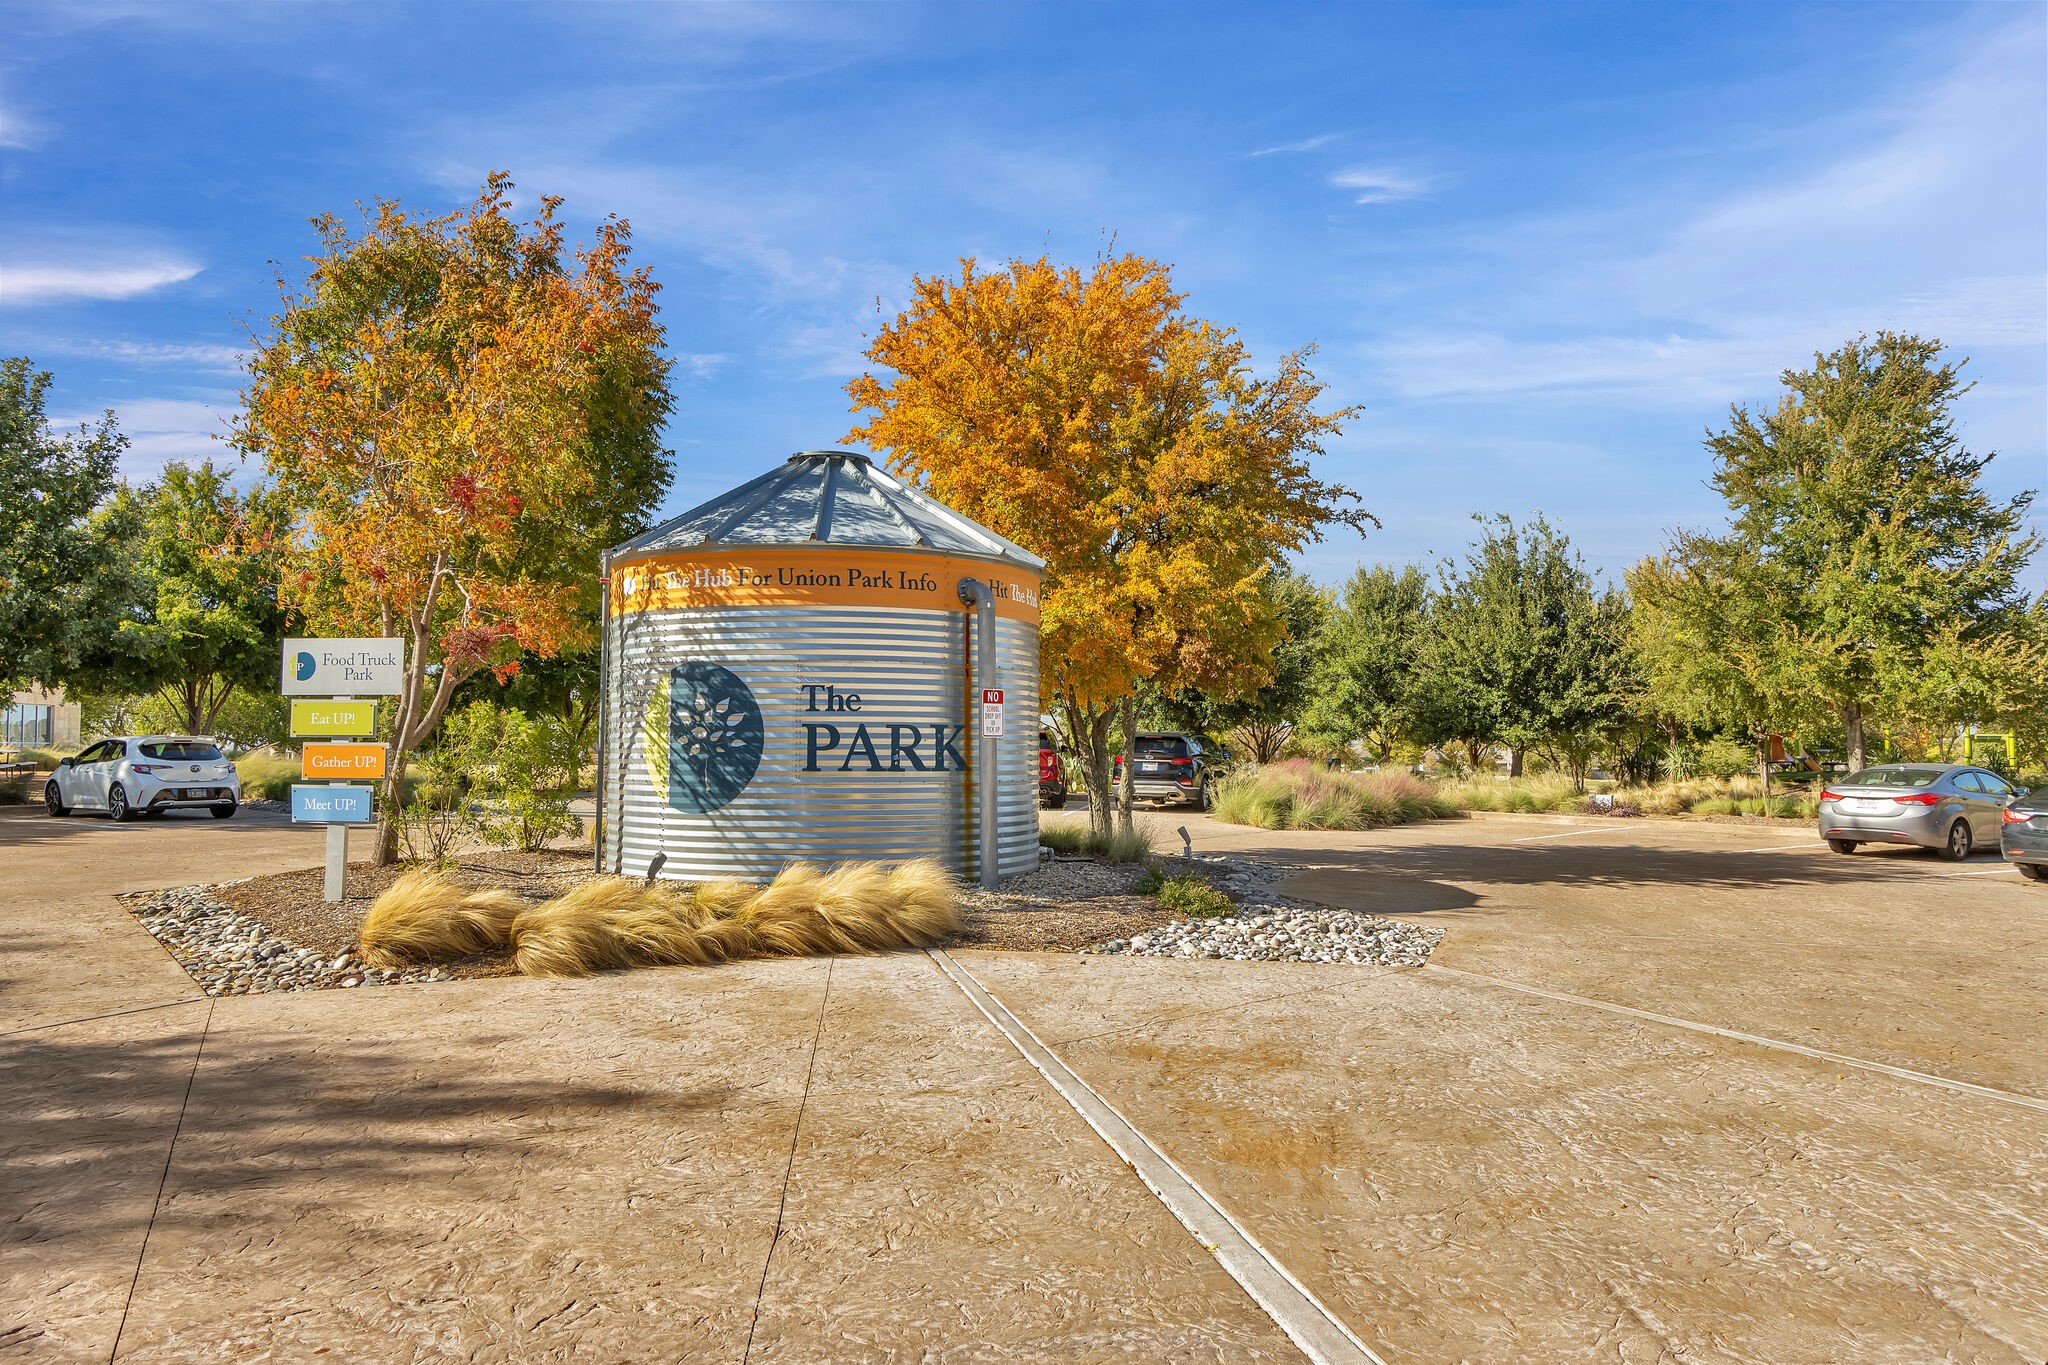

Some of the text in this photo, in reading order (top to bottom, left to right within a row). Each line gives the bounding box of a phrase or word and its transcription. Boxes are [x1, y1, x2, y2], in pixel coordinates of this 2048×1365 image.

[665, 571, 690, 589] The
[694, 568, 733, 587] Hub
[737, 568, 772, 587] For
[777, 567, 841, 586] Union
[847, 568, 893, 589] Park
[898, 571, 937, 592] Info
[989, 579, 1008, 599] Hit
[1010, 583, 1025, 604] The
[322, 652, 396, 666] Food Truck
[289, 662, 304, 671] UP
[344, 667, 373, 681] Park
[801, 684, 862, 712] The
[987, 691, 1000, 702] NO
[310, 712, 356, 725] Eat UP!
[801, 723, 973, 772] PARK
[311, 756, 377, 768] Gather UP!
[304, 798, 356, 811] Meet UP!
